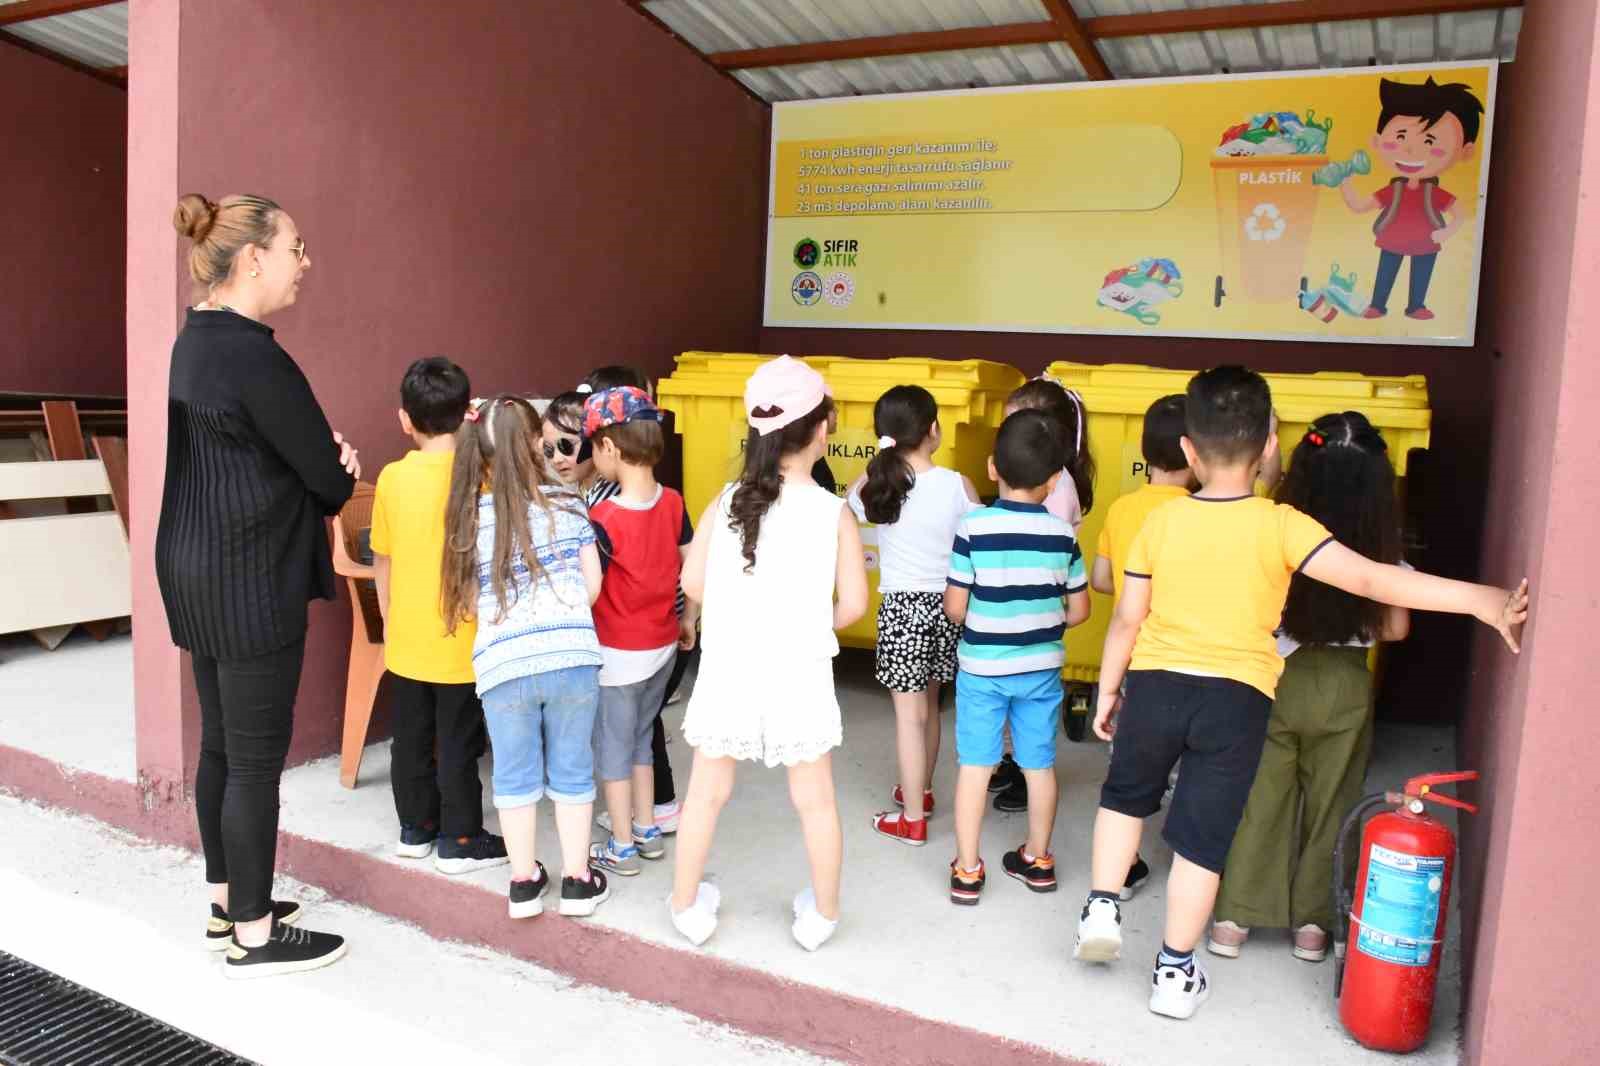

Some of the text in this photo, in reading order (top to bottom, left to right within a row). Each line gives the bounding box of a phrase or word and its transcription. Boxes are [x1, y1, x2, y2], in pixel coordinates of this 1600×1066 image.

[810, 147, 829, 159] ton
[888, 142, 912, 158] geri
[915, 140, 973, 153] kazanımı
[799, 164, 828, 177] 5774
[831, 163, 853, 176] kwh
[858, 162, 893, 177] enerji
[1239, 168, 1302, 185] PLASTİK
[816, 182, 834, 194] ton
[836, 200, 895, 214] depolama
[823, 239, 858, 253] SIFIR
[823, 253, 857, 268] ATIK
[827, 443, 876, 459] IKLAR
